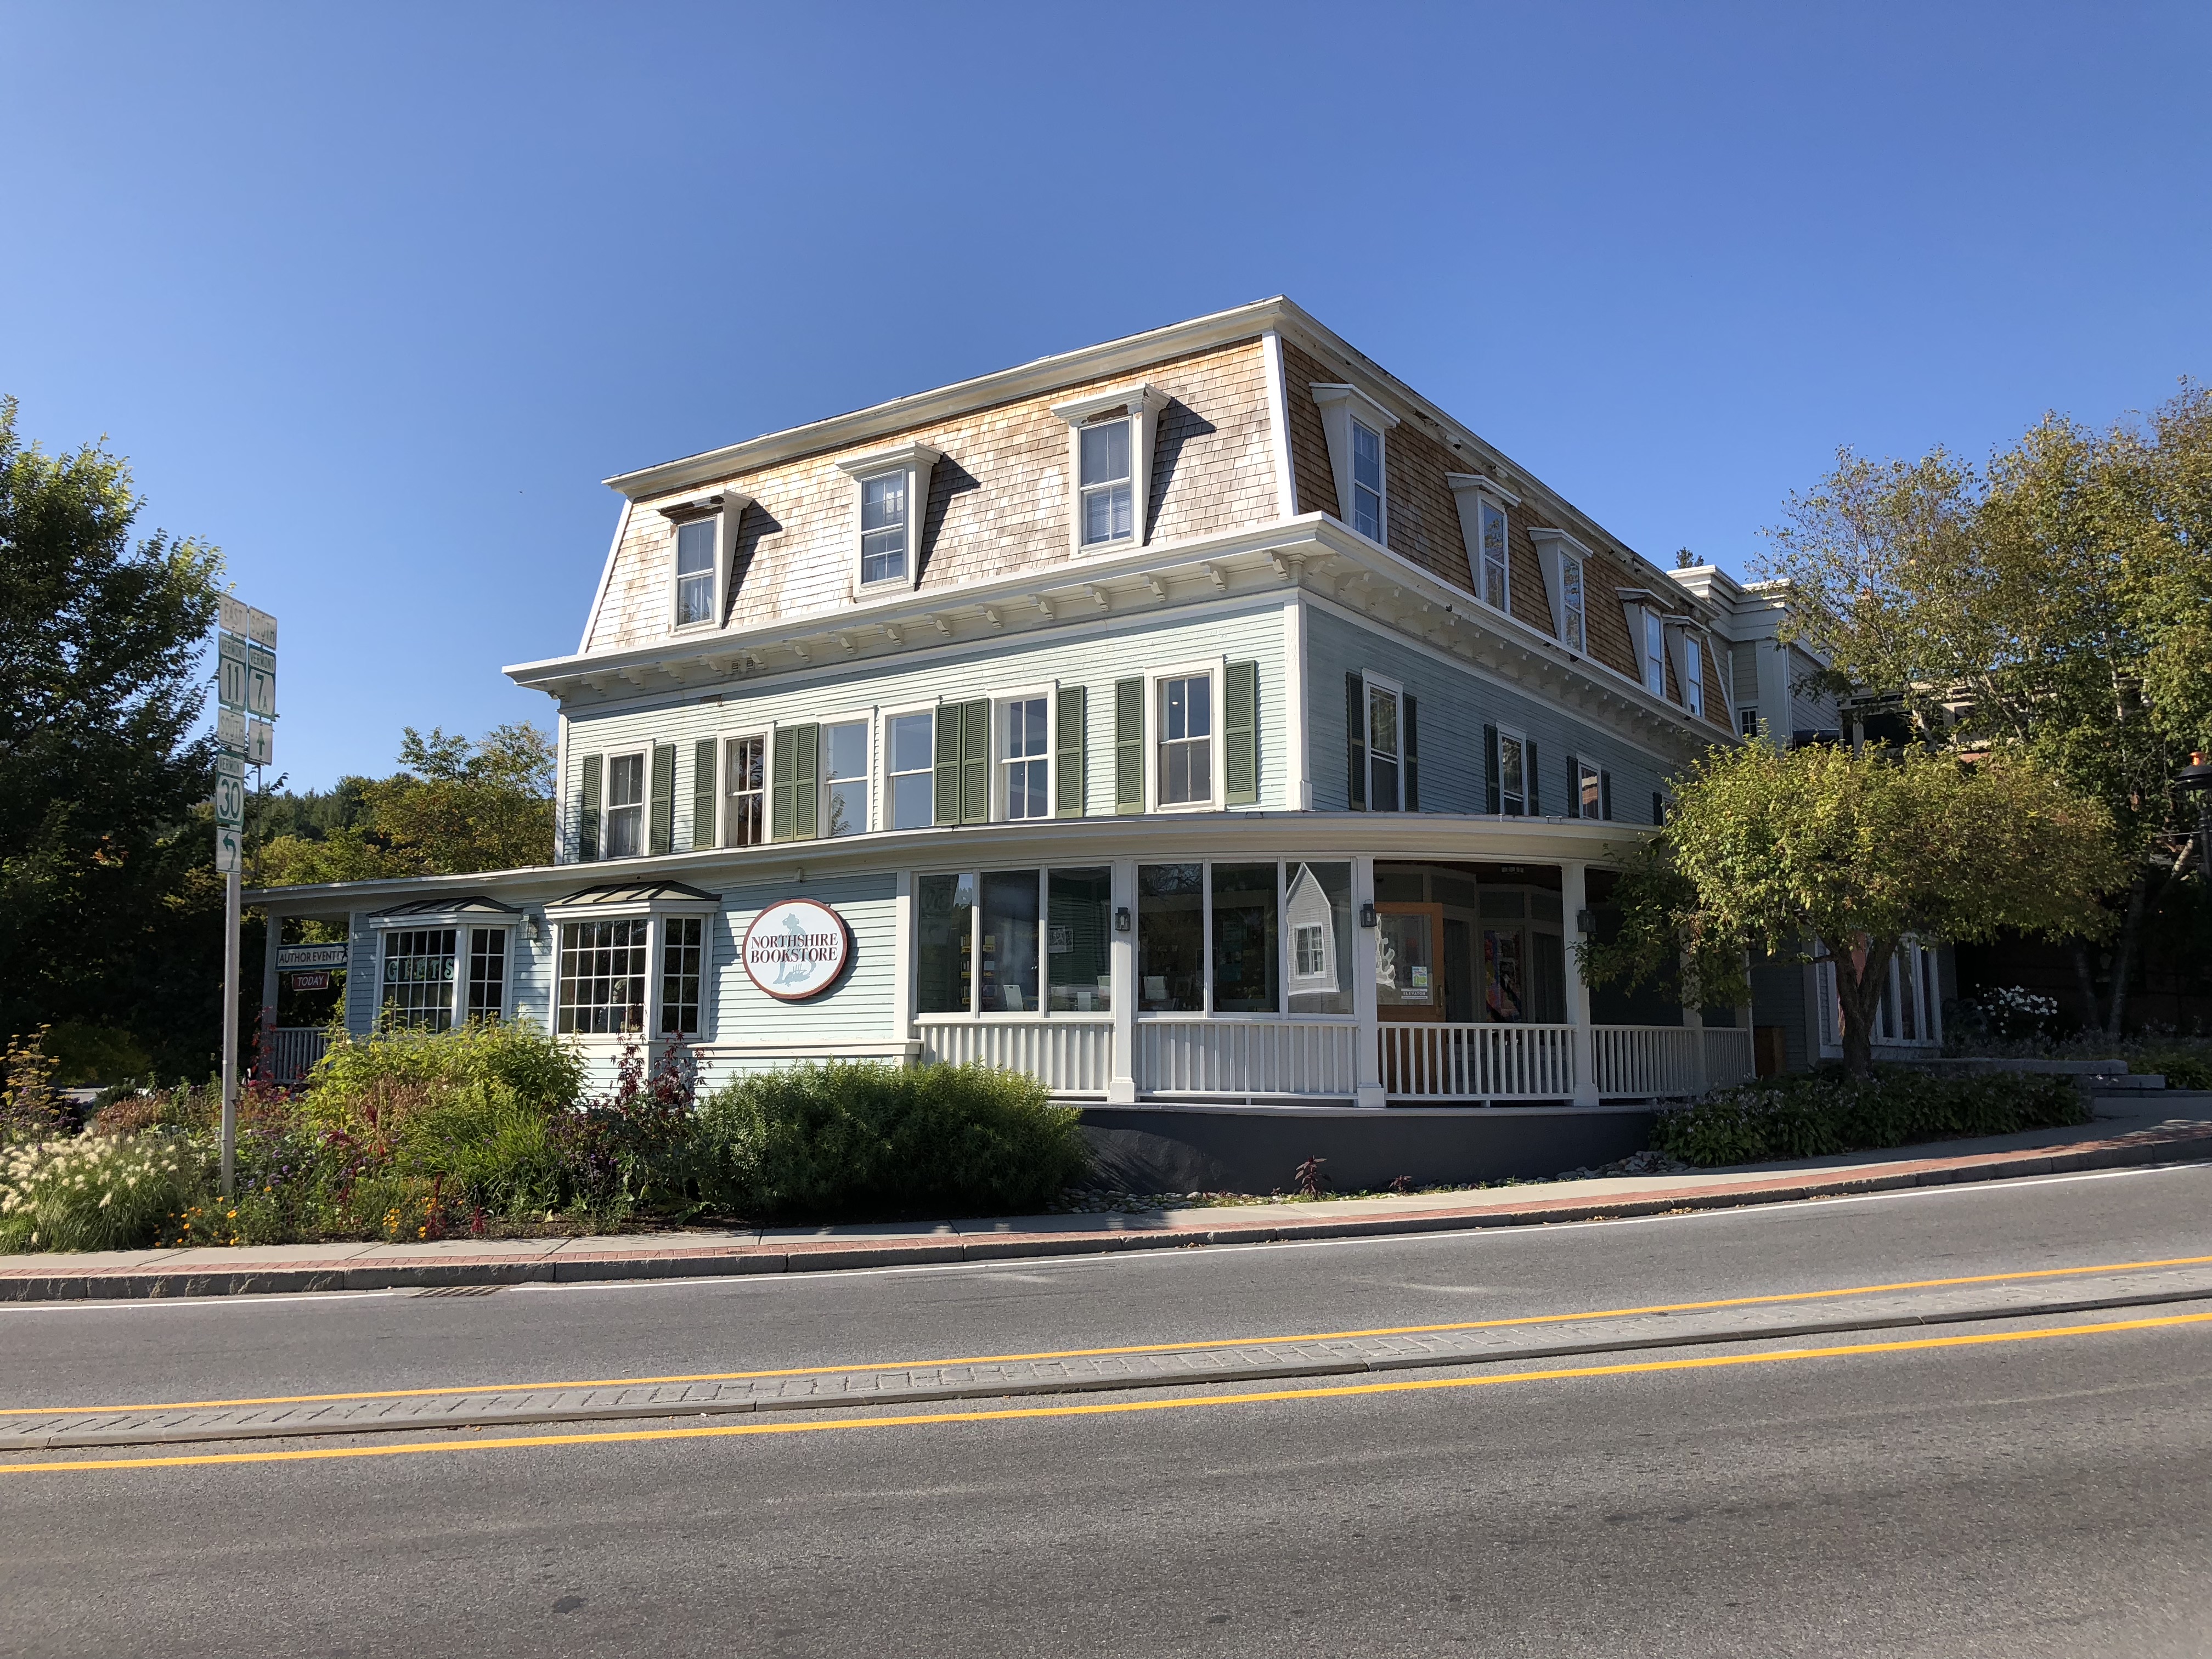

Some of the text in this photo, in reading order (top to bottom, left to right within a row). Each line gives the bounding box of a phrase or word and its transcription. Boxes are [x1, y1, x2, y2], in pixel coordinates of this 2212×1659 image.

[224, 603, 242, 628] EAST
[251, 615, 275, 642] SOUTH
[221, 639, 245, 661] VERMONT
[250, 651, 274, 670] VERMONT
[227, 663, 239, 702] 11
[221, 715, 244, 740] SOUTH
[220, 757, 243, 774] VERMONT
[219, 778, 240, 819] 30
[751, 933, 838, 949] NORTHSHIRE
[279, 952, 311, 963] AUTHOR
[751, 947, 838, 963] BOOKSTORE
[387, 958, 454, 981] GIFTS
[297, 975, 324, 987] TODAY
